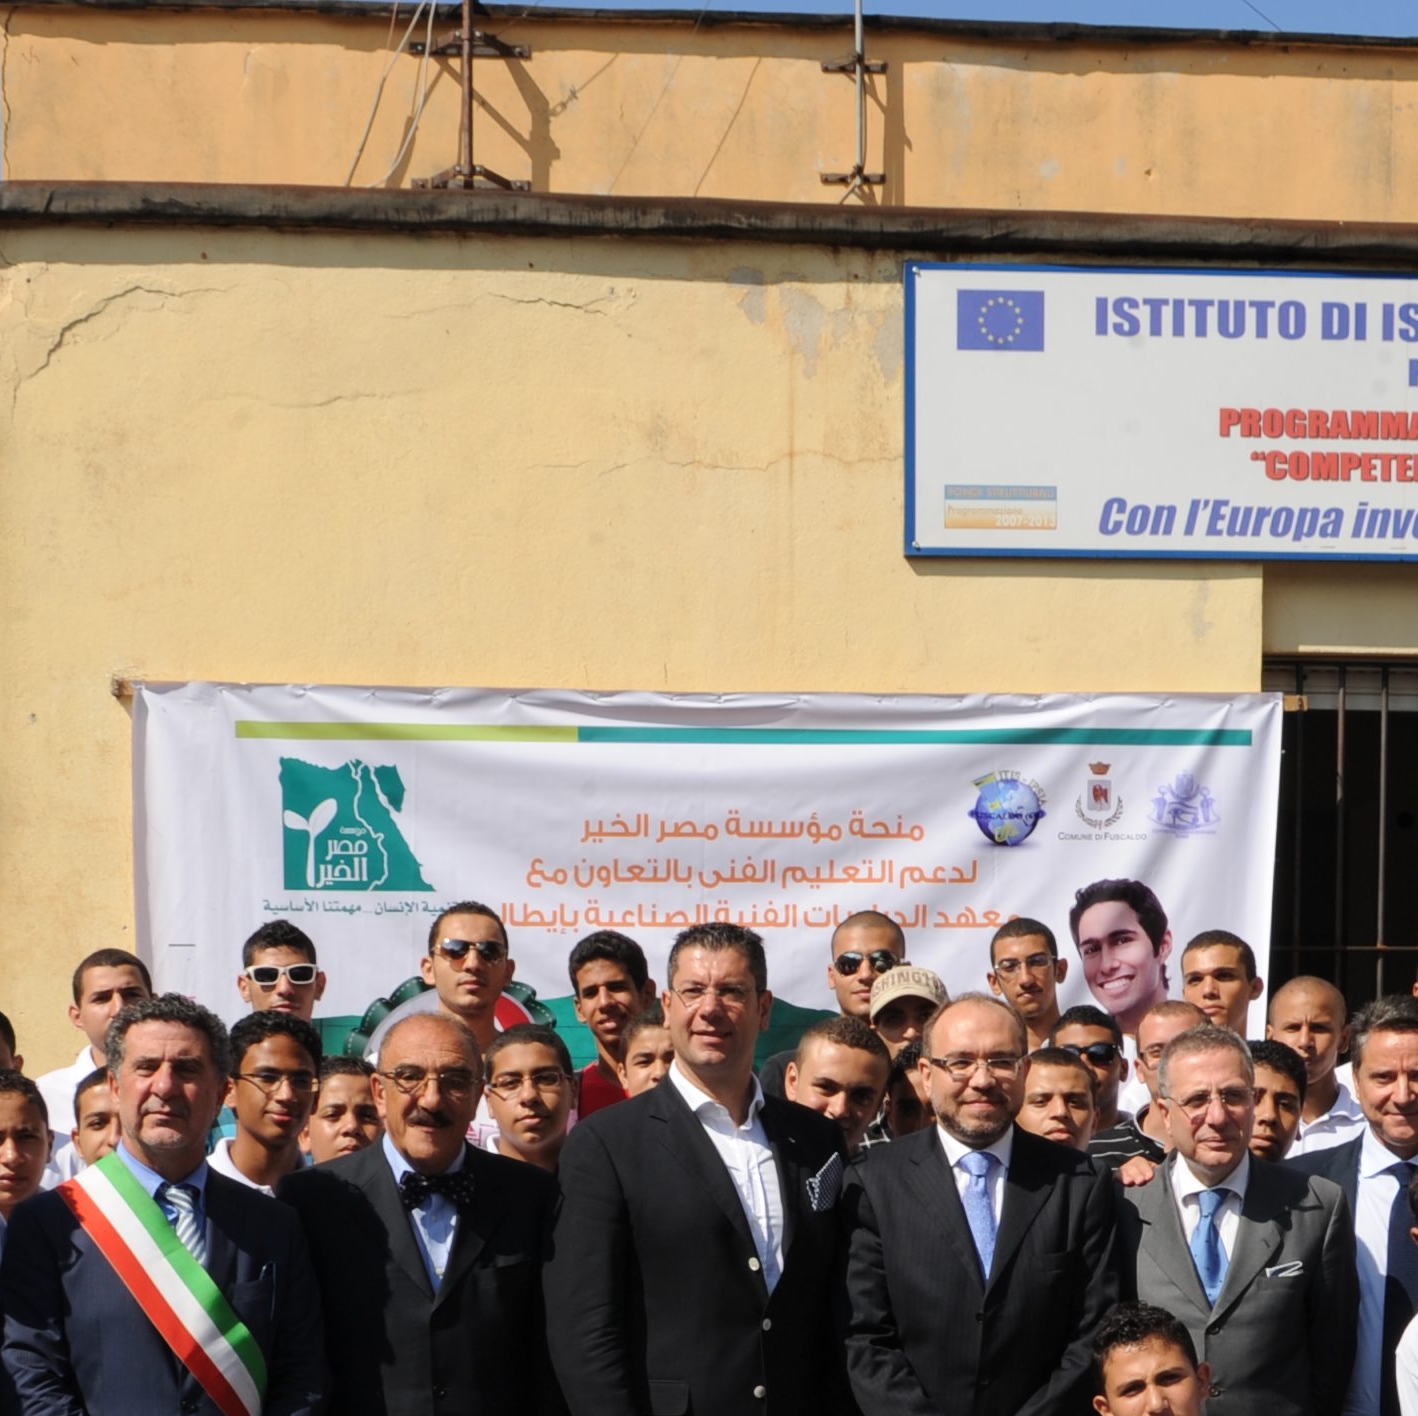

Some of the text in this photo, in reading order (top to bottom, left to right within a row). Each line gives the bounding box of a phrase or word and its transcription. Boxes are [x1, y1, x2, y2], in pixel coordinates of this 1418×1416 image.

[1095, 296, 1307, 340] ISTITUTO
[1321, 302, 1368, 341] DI
[996, 514, 1056, 527] 2007-2013
[1098, 497, 1177, 536] Con
[580, 809, 925, 844] منحة مؤسسة مصر الخير
[325, 839, 368, 861] مصر
[316, 856, 368, 888] الخير
[526, 858, 568, 889] مع
[574, 858, 693, 889] بالتعاون
[782, 859, 894, 889] التعليم
[900, 859, 978, 889] لدعم
[262, 897, 319, 916] الأساسية
